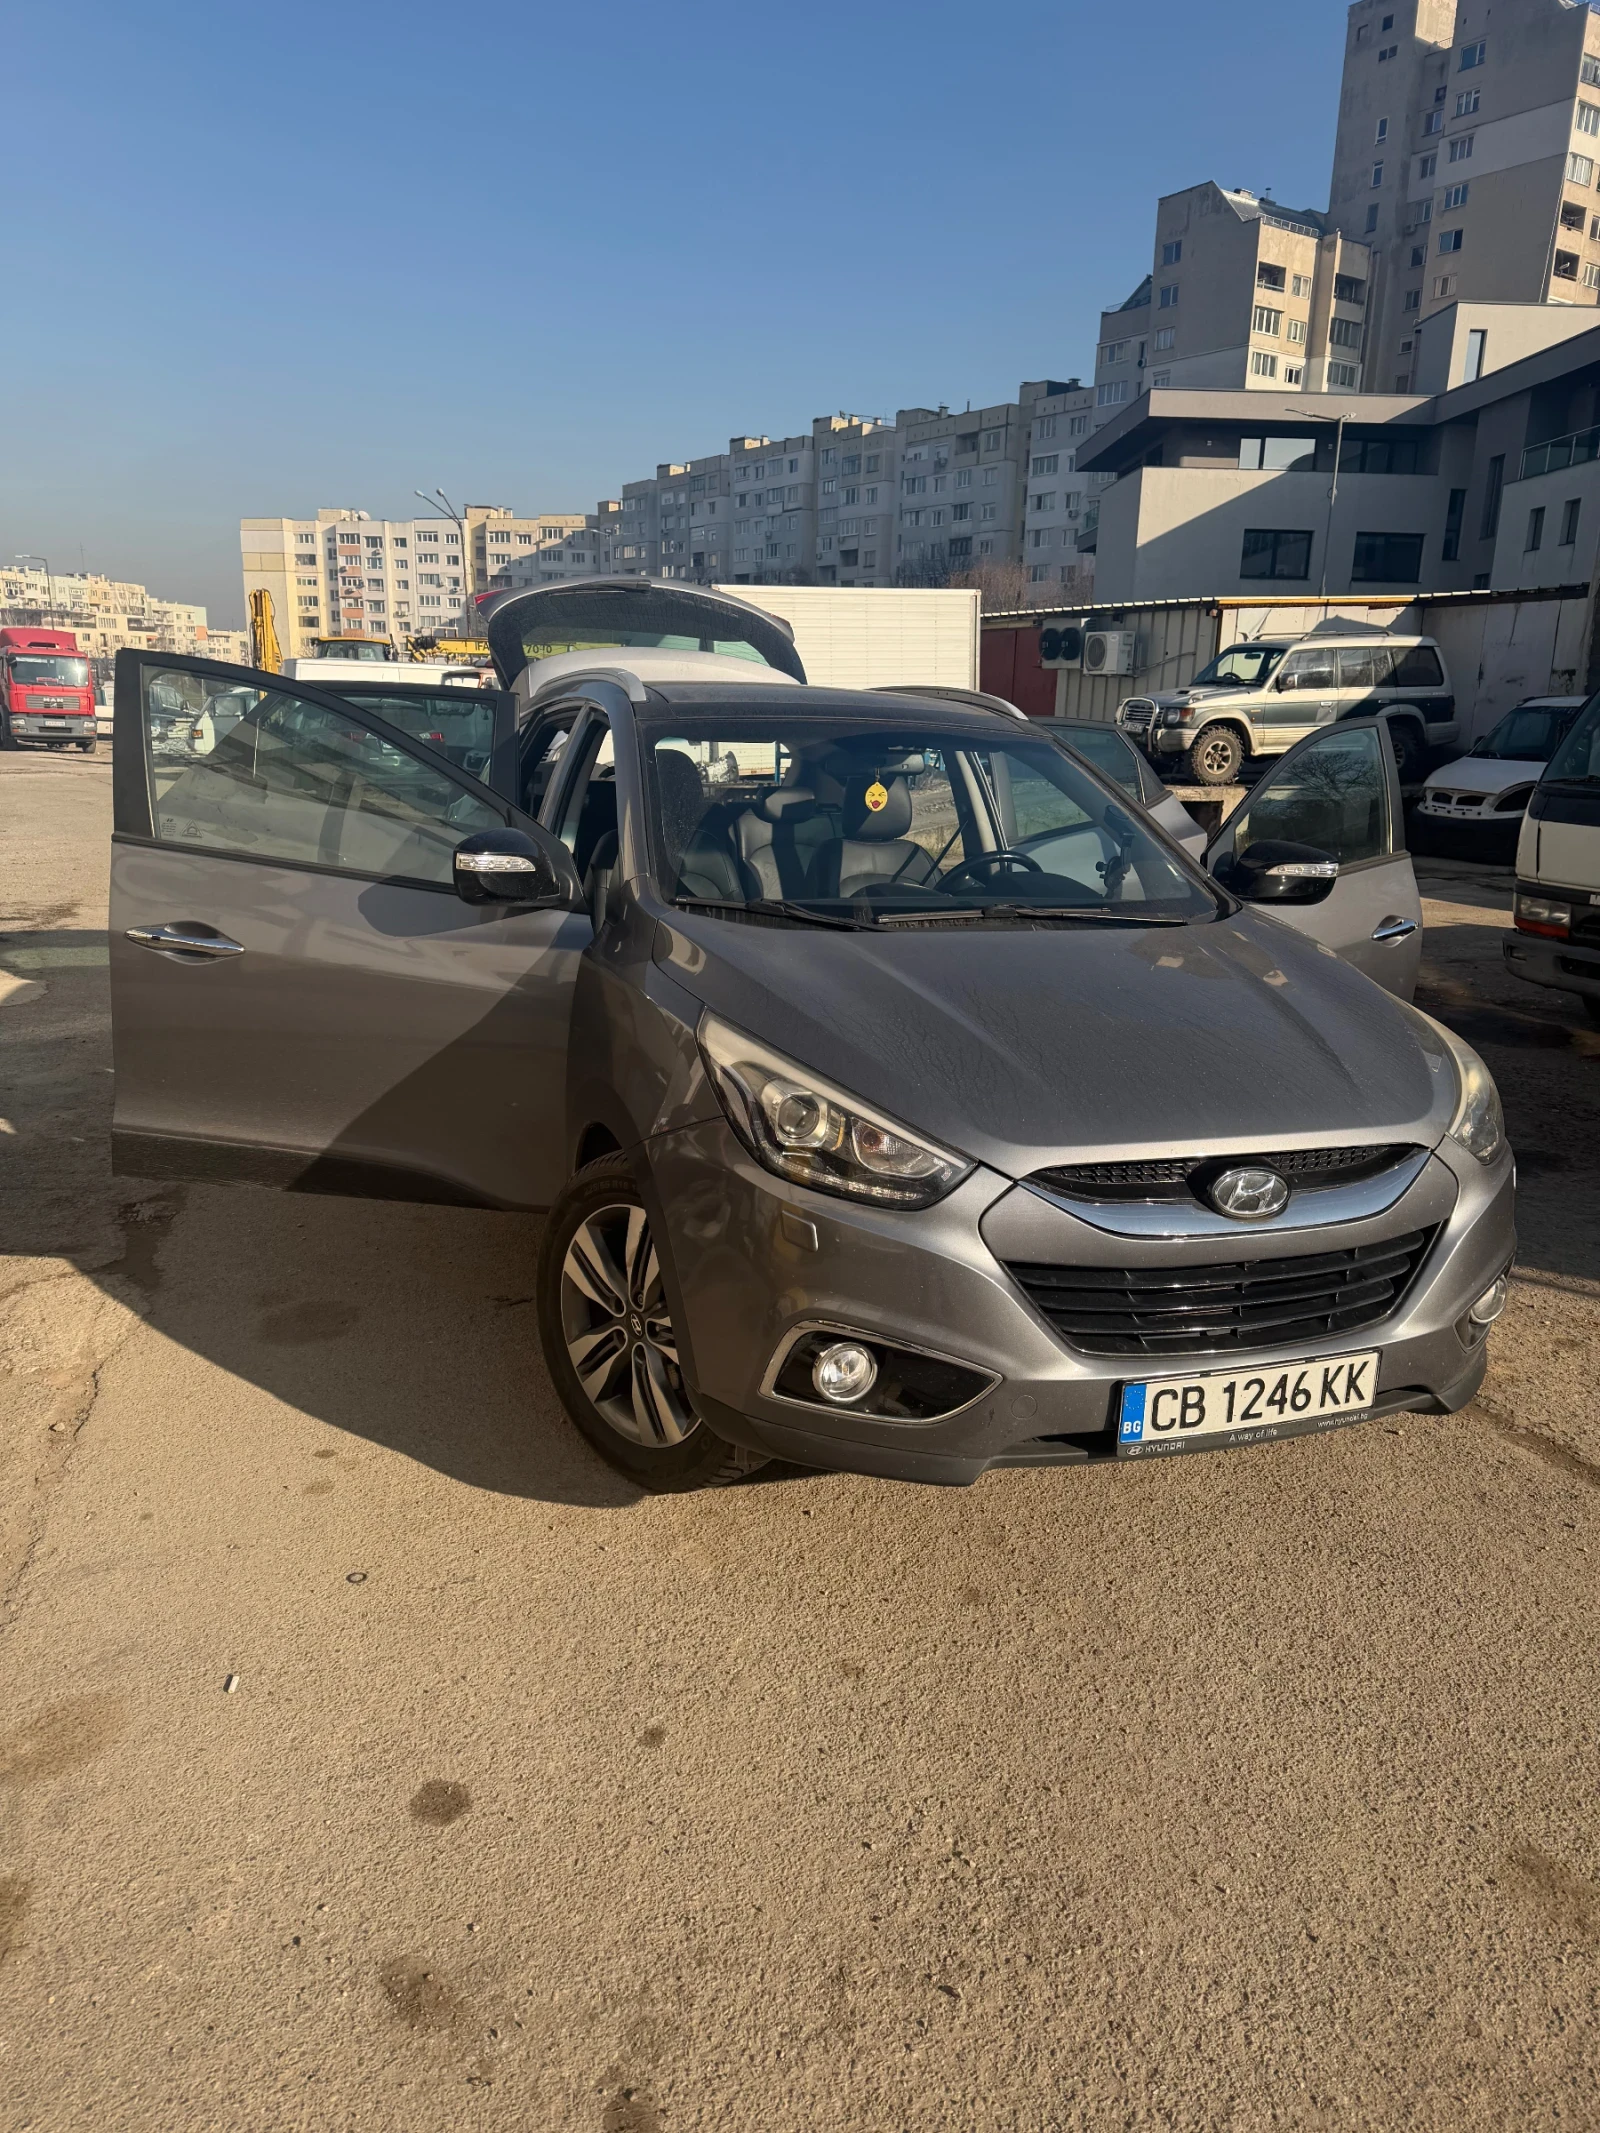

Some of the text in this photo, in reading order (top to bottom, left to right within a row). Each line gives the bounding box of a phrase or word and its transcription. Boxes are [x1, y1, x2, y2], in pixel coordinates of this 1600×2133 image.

[1151, 1361, 1369, 1431] CB 1246 KK
[1123, 1421, 1141, 1434] BG
[1229, 1428, 1278, 1442] A way of life
[1145, 1442, 1185, 1453] HYUNDAI
